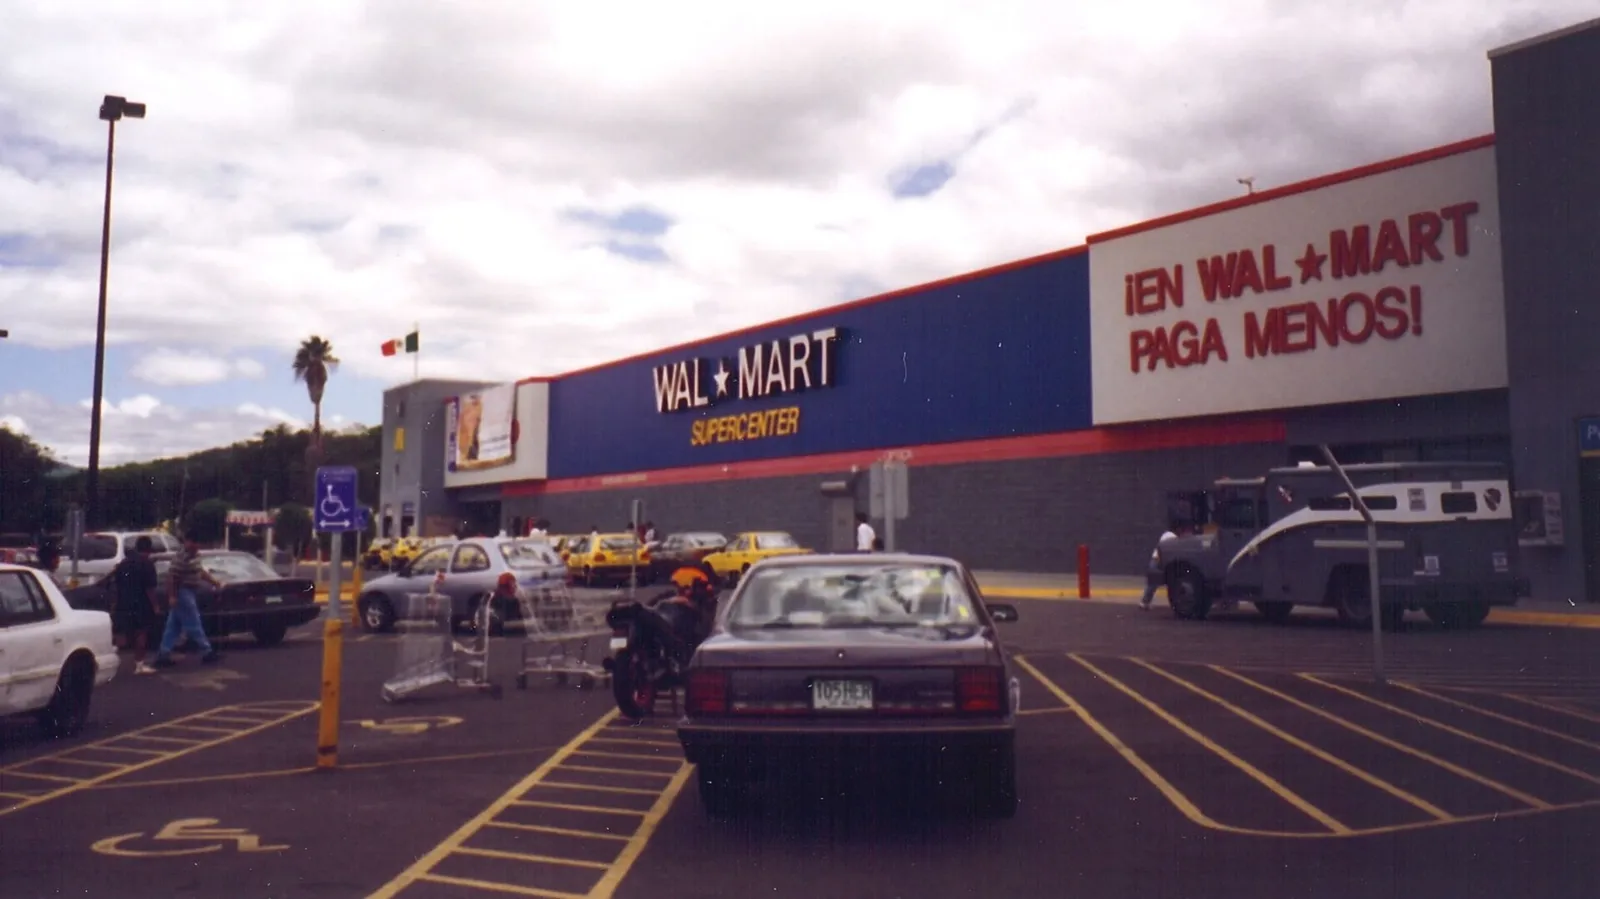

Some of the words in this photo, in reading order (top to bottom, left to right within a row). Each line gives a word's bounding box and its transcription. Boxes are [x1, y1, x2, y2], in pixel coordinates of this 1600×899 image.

[1124, 264, 1184, 316] ¡EN
[1197, 244, 1291, 302] WAL
[1330, 201, 1479, 279] MART
[652, 357, 709, 413] WAL
[738, 328, 836, 398] MART
[1129, 318, 1228, 374] PAGA
[1245, 285, 1423, 359] MENOS!
[690, 406, 800, 446] SUPERCENTER
